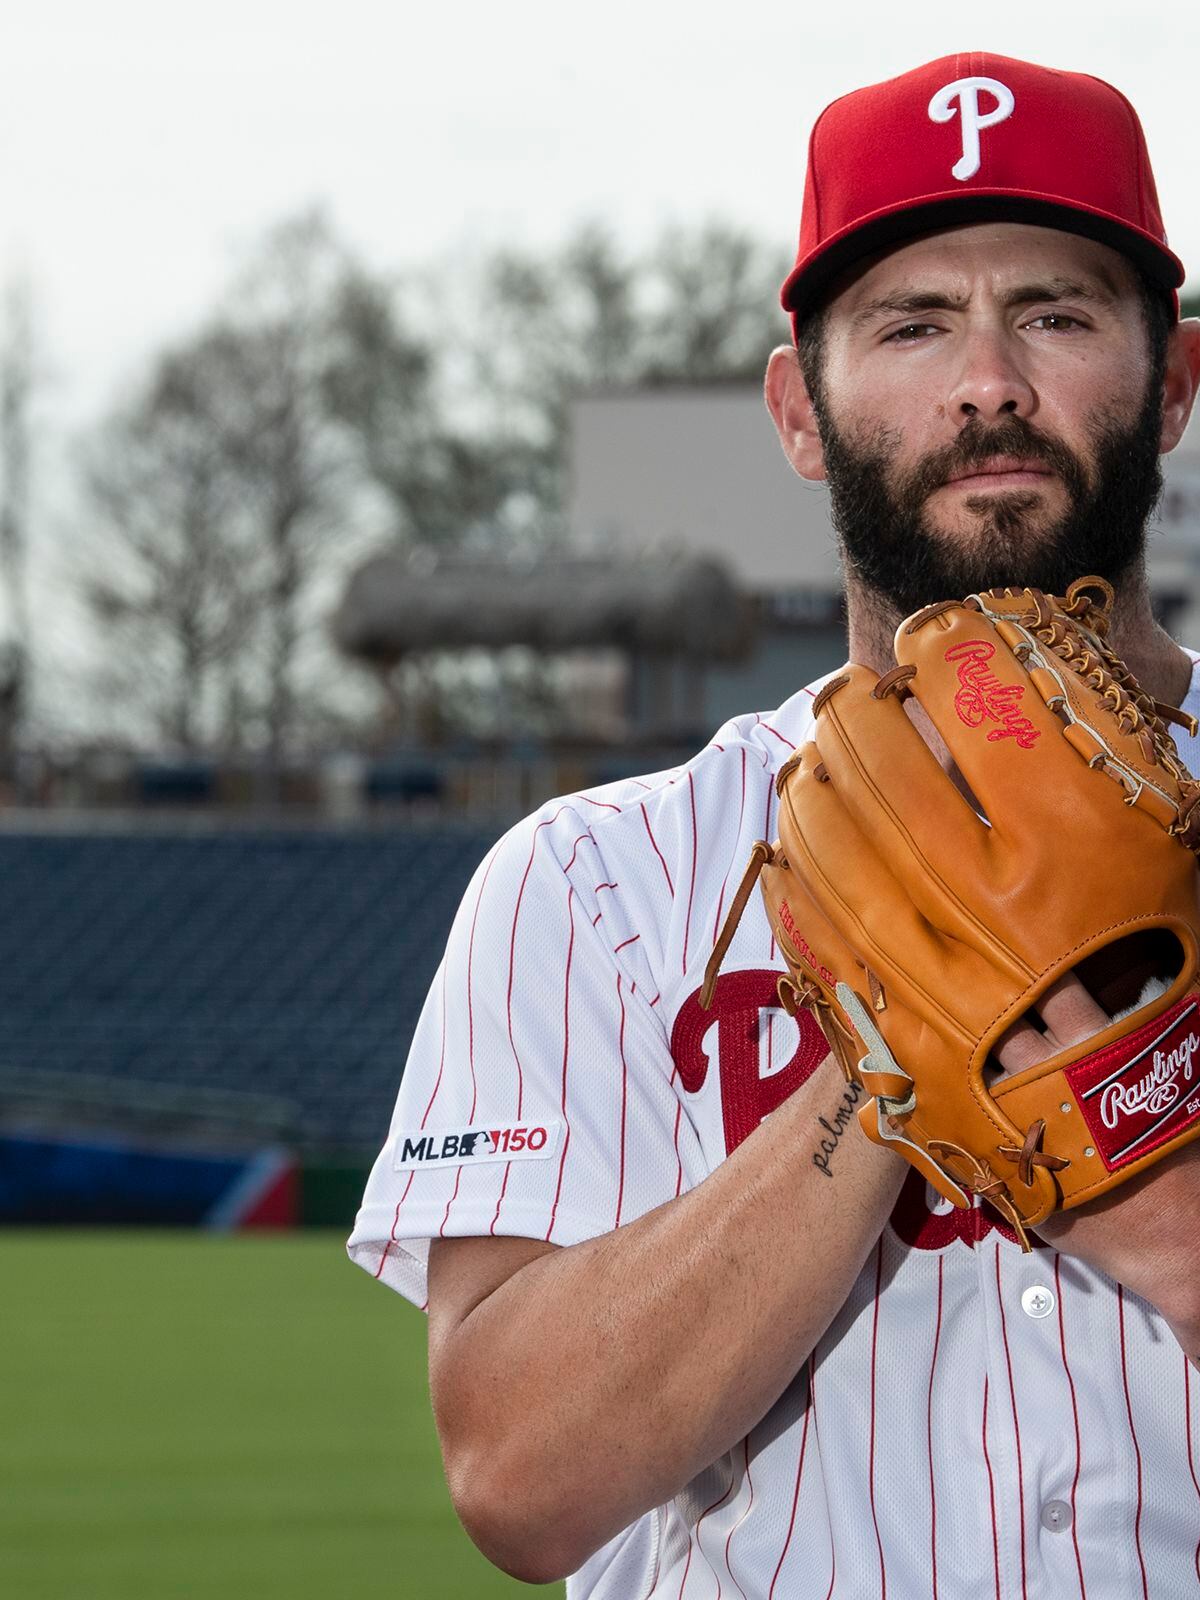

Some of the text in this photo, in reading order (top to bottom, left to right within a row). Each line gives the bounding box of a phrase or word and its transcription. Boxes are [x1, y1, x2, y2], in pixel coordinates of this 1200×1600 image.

[927, 76, 1016, 182] P
[944, 639, 1041, 749] Rawlings
[1099, 1031, 1200, 1129] Rawlings
[400, 1126, 548, 1163] MLB 150
